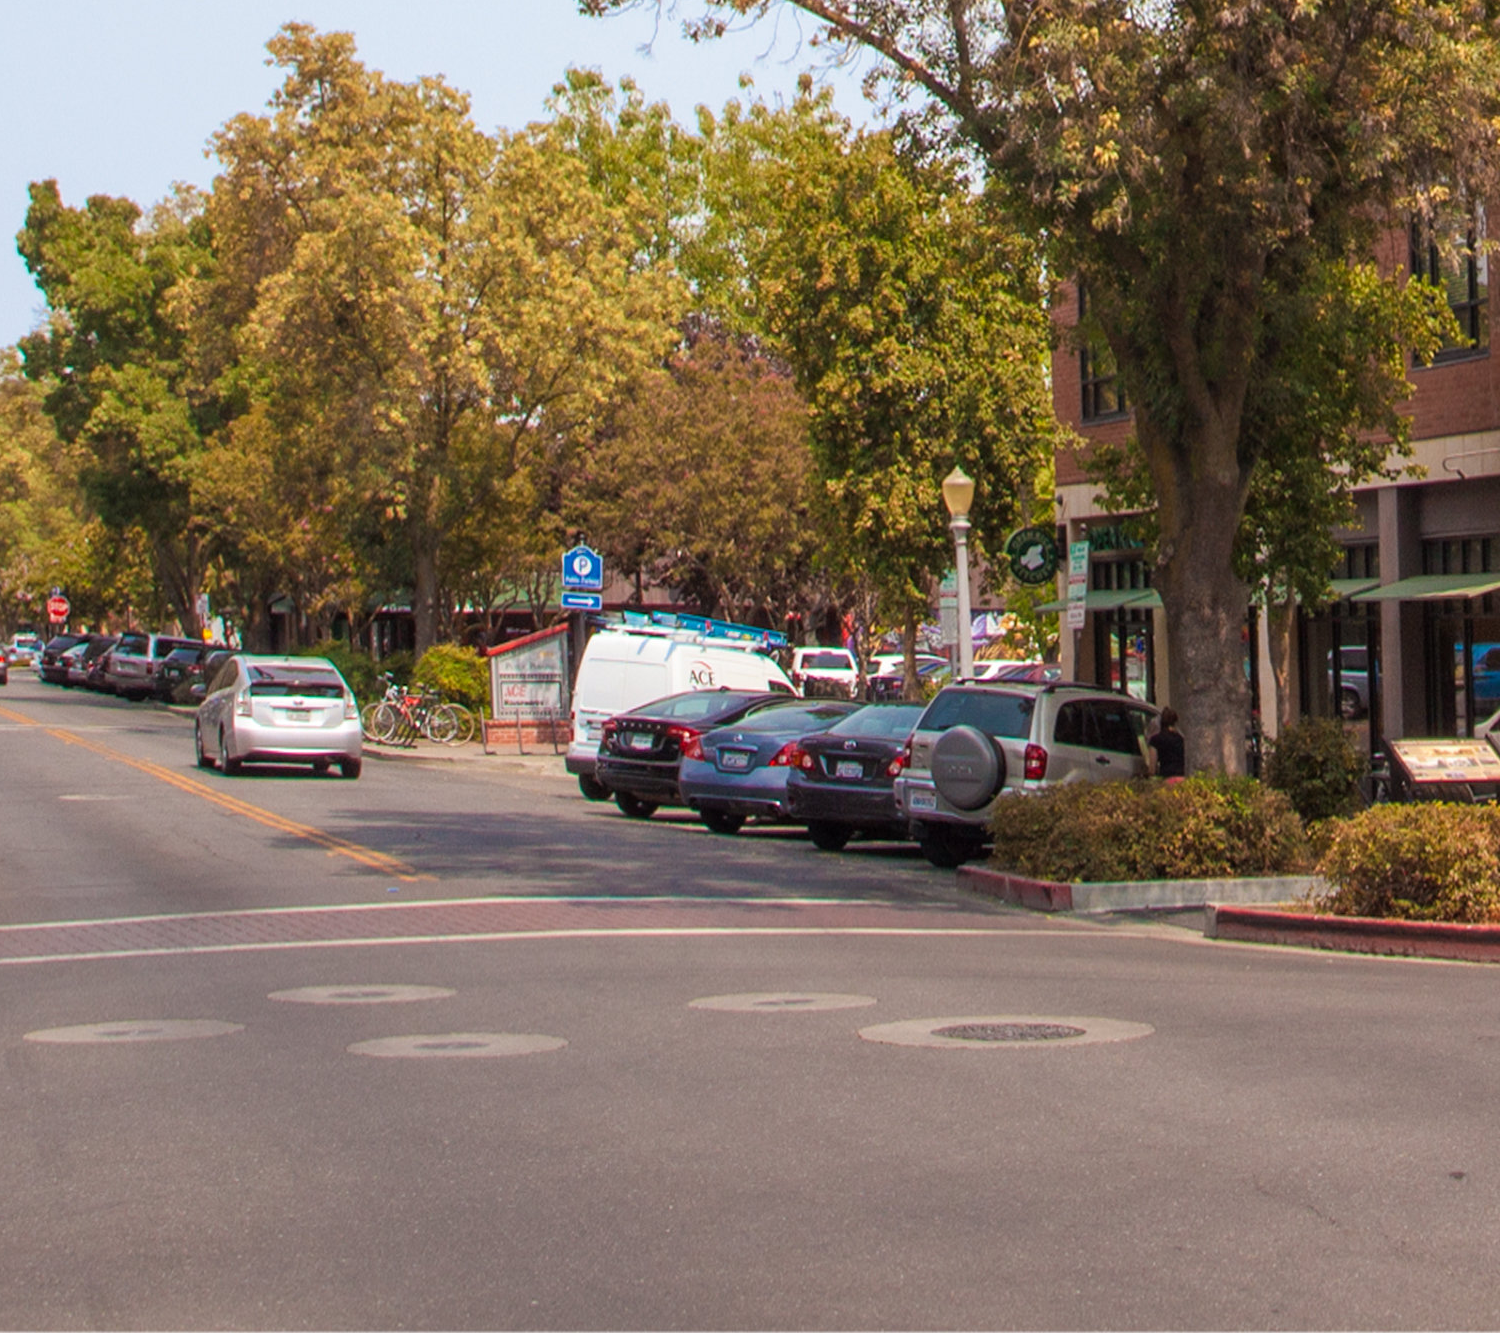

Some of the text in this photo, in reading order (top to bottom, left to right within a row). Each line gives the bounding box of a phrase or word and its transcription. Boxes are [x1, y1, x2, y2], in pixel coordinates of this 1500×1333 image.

[579, 557, 588, 573] P
[689, 669, 716, 686] ACE
[504, 684, 526, 697] ACE
